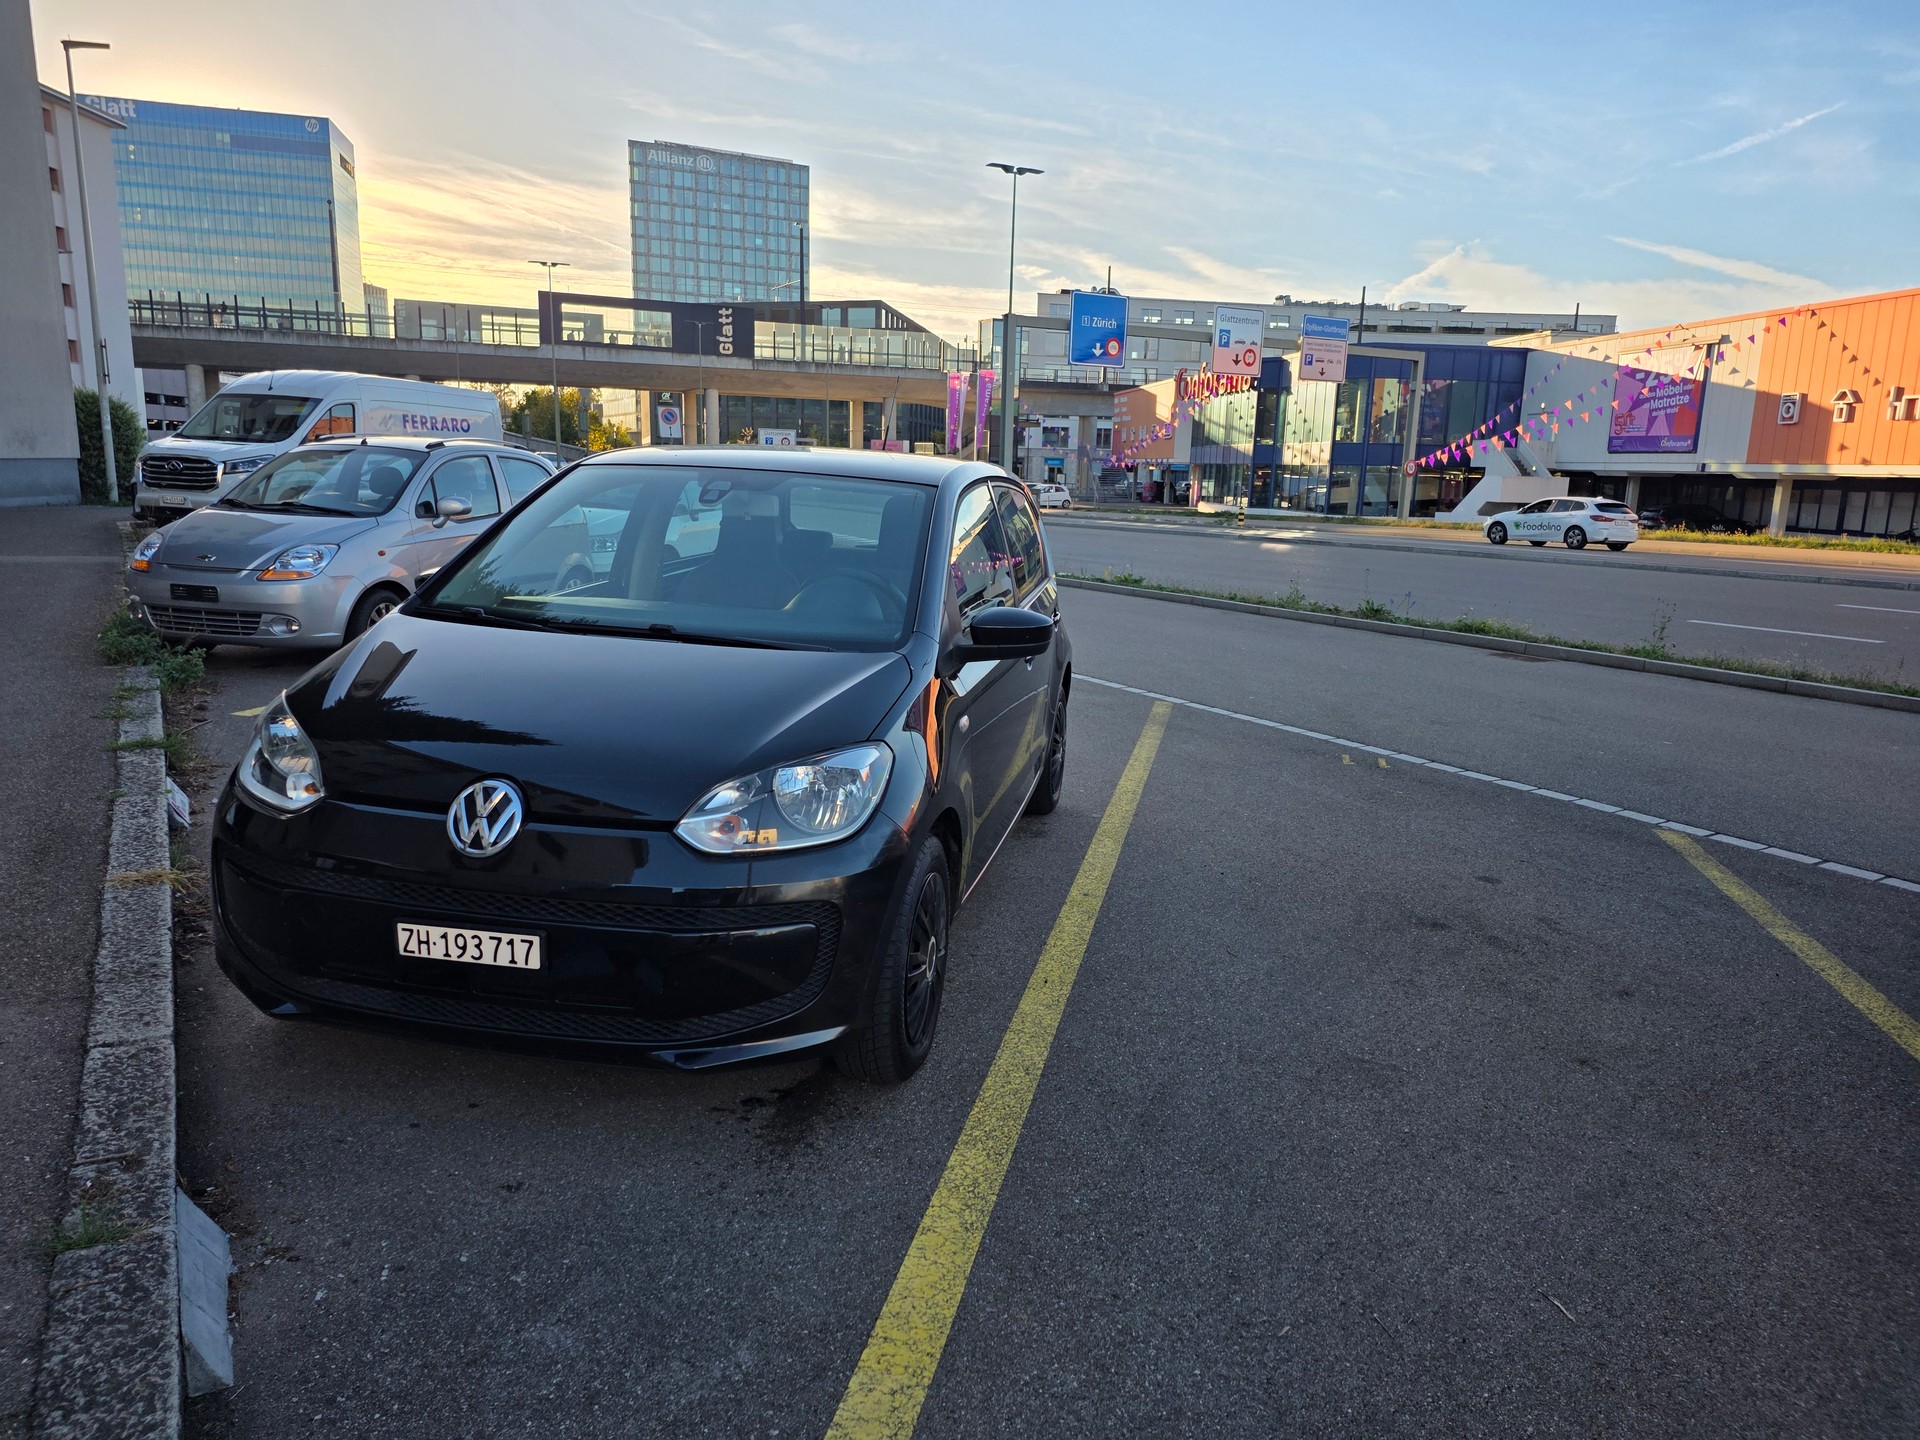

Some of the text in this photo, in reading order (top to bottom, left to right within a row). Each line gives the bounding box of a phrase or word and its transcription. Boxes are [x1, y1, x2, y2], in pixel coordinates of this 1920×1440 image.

[85, 96, 137, 118] Glatt
[648, 149, 694, 167] Allianz
[1092, 317, 1117, 329] Zürich
[1220, 314, 1260, 326] Glattzentrum
[716, 307, 733, 355] Glatt
[1656, 382, 1683, 398] Möbel
[1650, 394, 1690, 410] Matratze
[402, 413, 471, 434] FERRARO
[1660, 438, 1689, 448] Conforama
